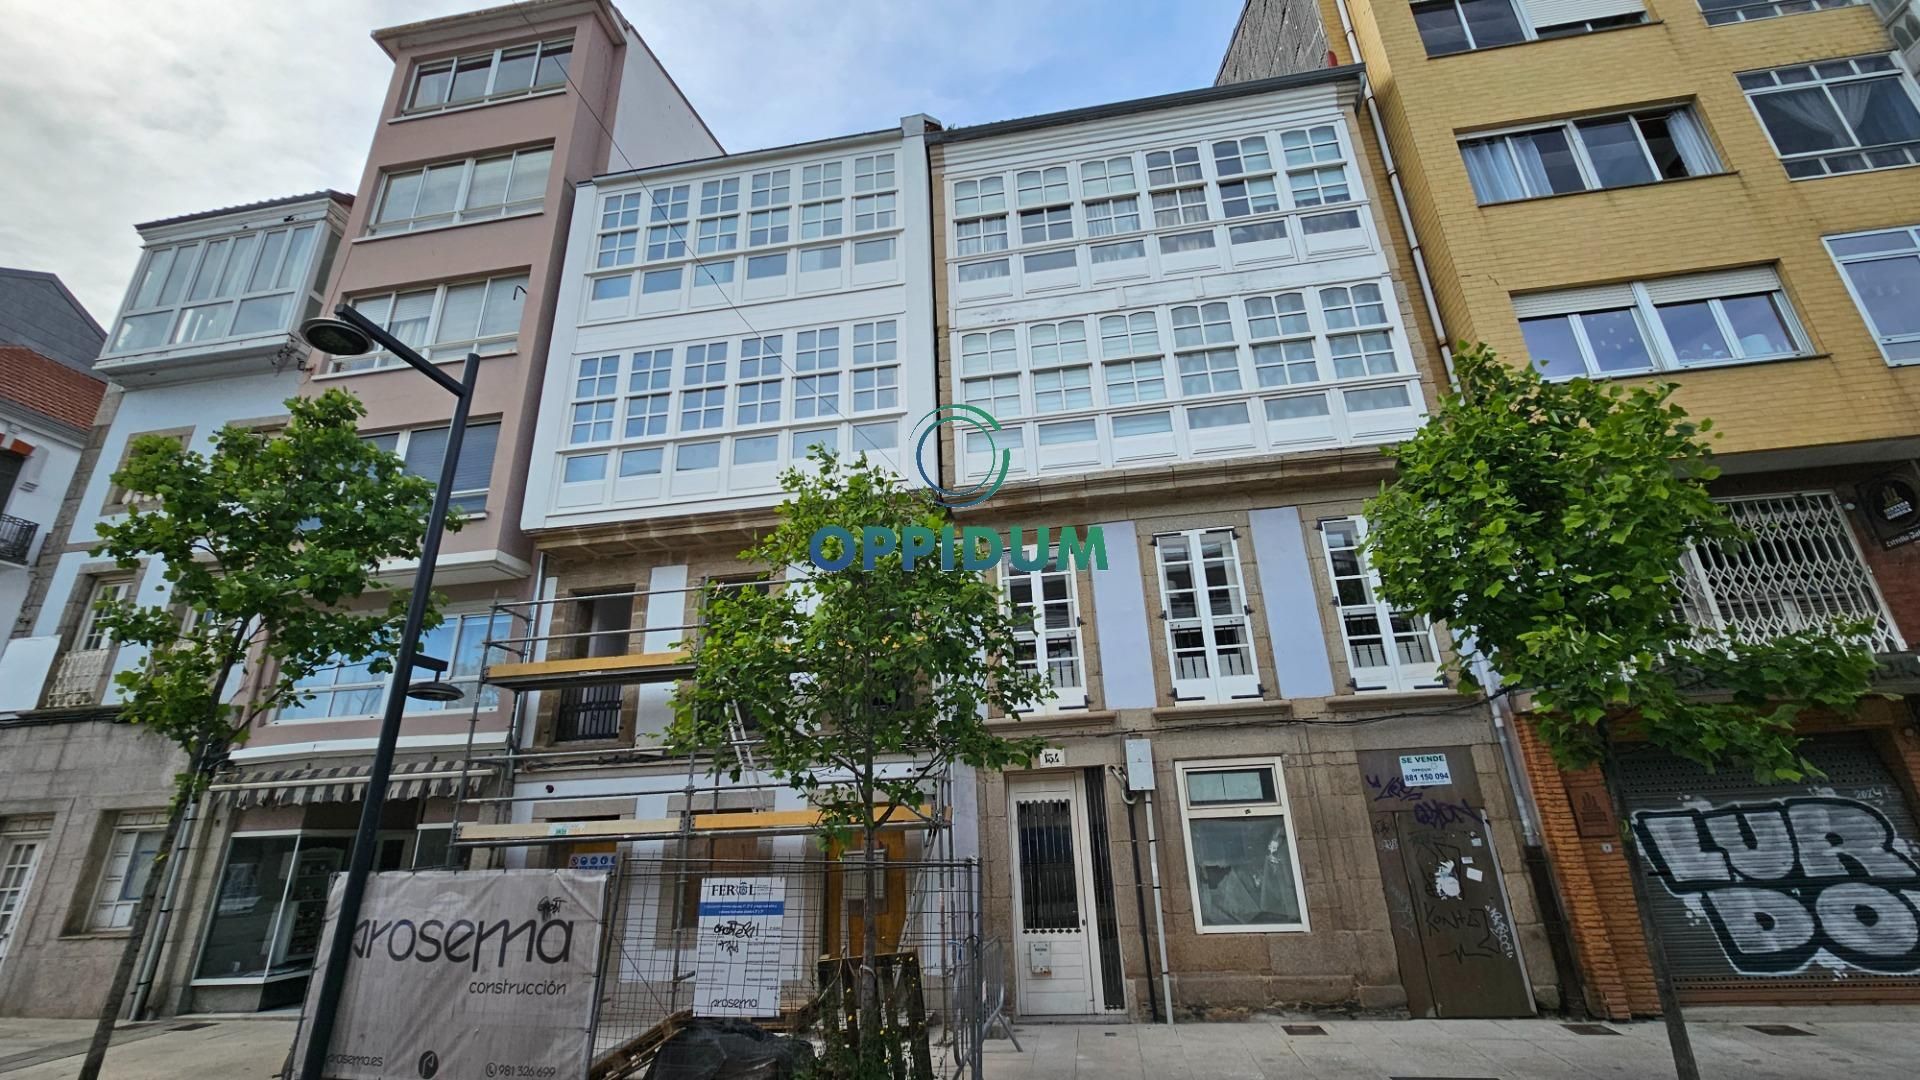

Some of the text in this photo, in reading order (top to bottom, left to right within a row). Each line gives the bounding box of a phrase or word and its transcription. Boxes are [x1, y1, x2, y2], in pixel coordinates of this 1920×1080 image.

[1435, 772, 1449, 780] 094
[1634, 798, 1920, 890] LUR
[469, 978, 567, 996] construcción
[498, 1064, 556, 1078] 981 326 699
